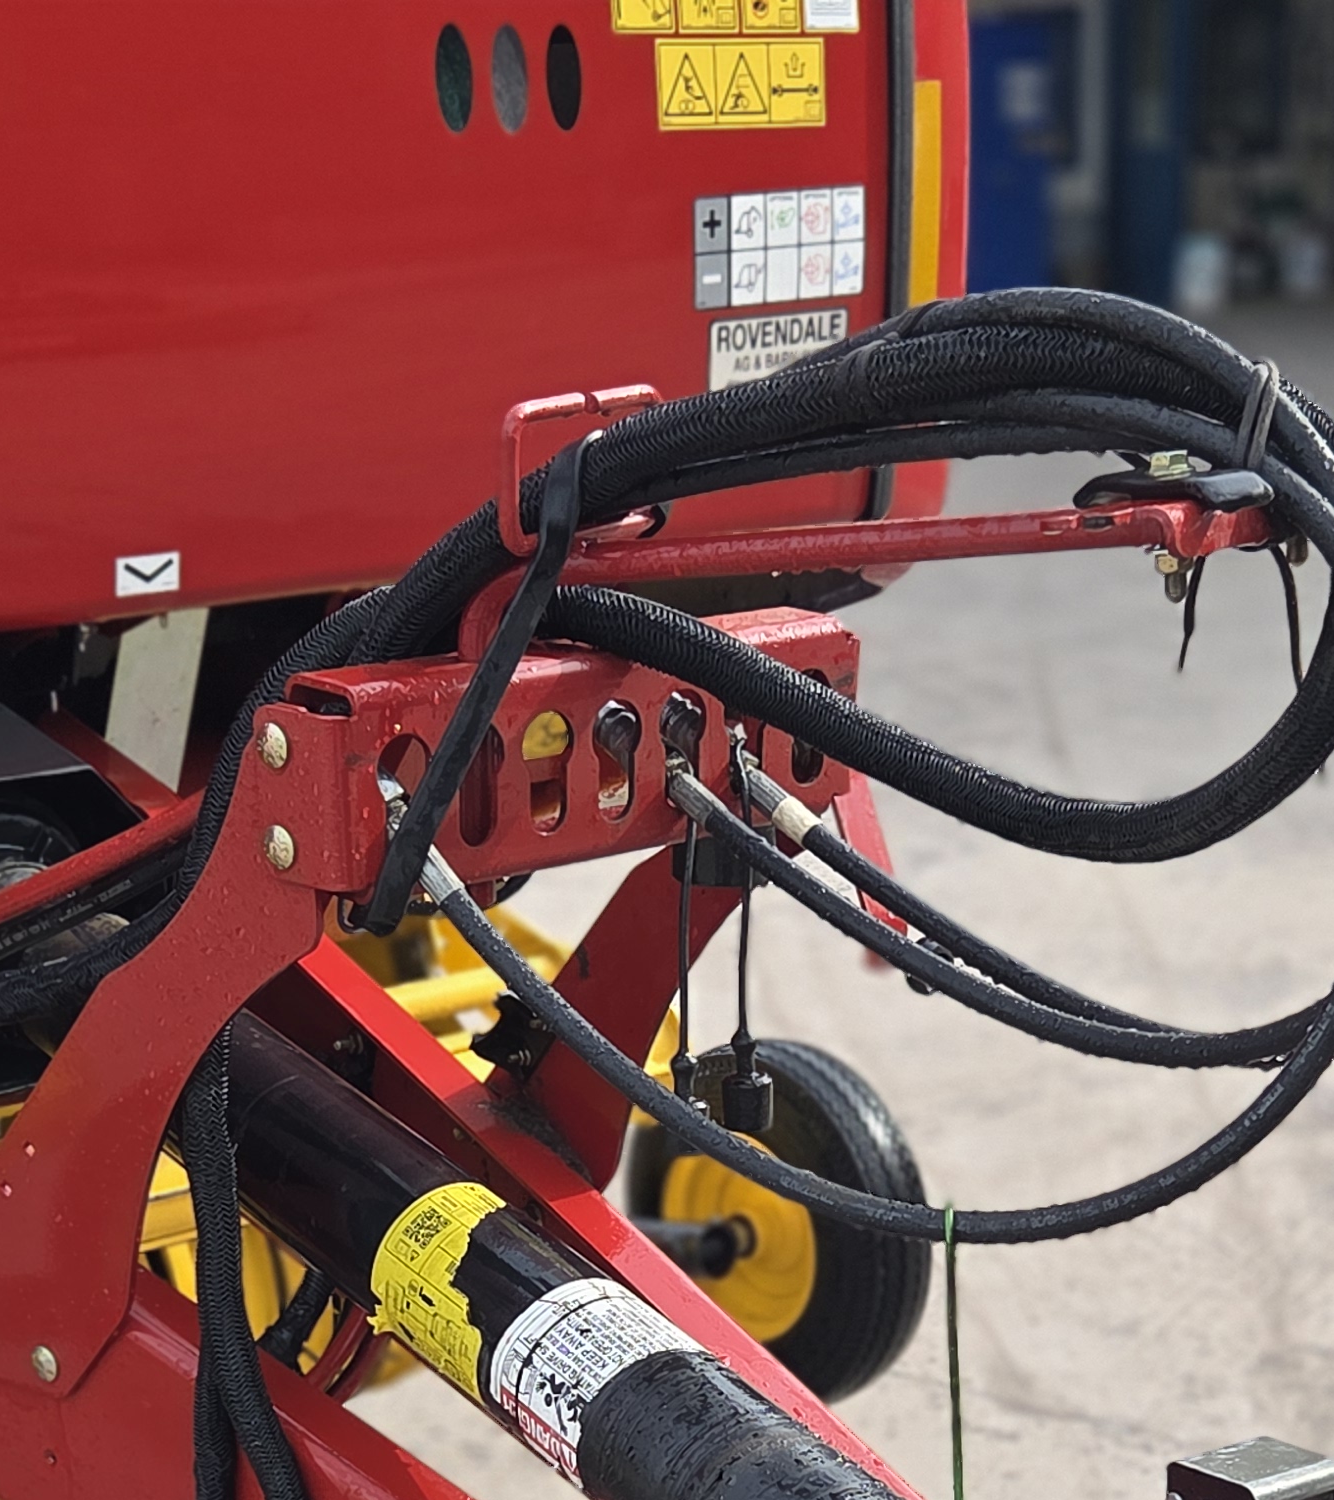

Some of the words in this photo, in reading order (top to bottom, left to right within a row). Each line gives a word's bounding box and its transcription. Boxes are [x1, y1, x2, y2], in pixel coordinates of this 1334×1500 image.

[716, 313, 842, 353] ROVENDALE
[733, 354, 750, 372] AG
[552, 1322, 586, 1352] AWAY!
[579, 1346, 609, 1370] KEEP
